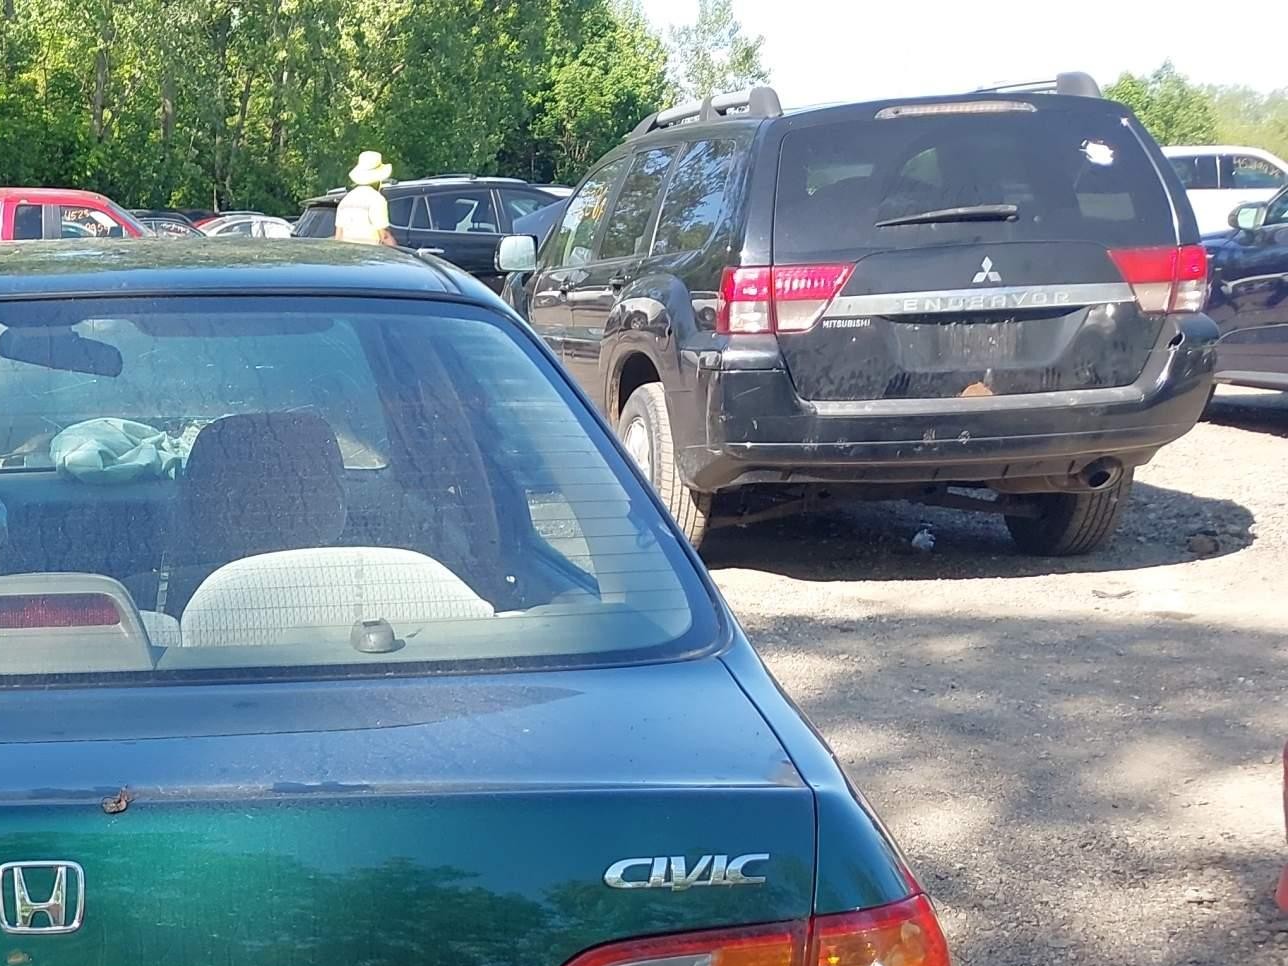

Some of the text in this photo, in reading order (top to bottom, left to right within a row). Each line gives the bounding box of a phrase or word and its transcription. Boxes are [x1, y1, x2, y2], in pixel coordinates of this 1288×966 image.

[903, 292, 1070, 312] ENDEAVOR
[822, 319, 871, 329] MITSUBISHI
[604, 853, 769, 891] CIVIC
